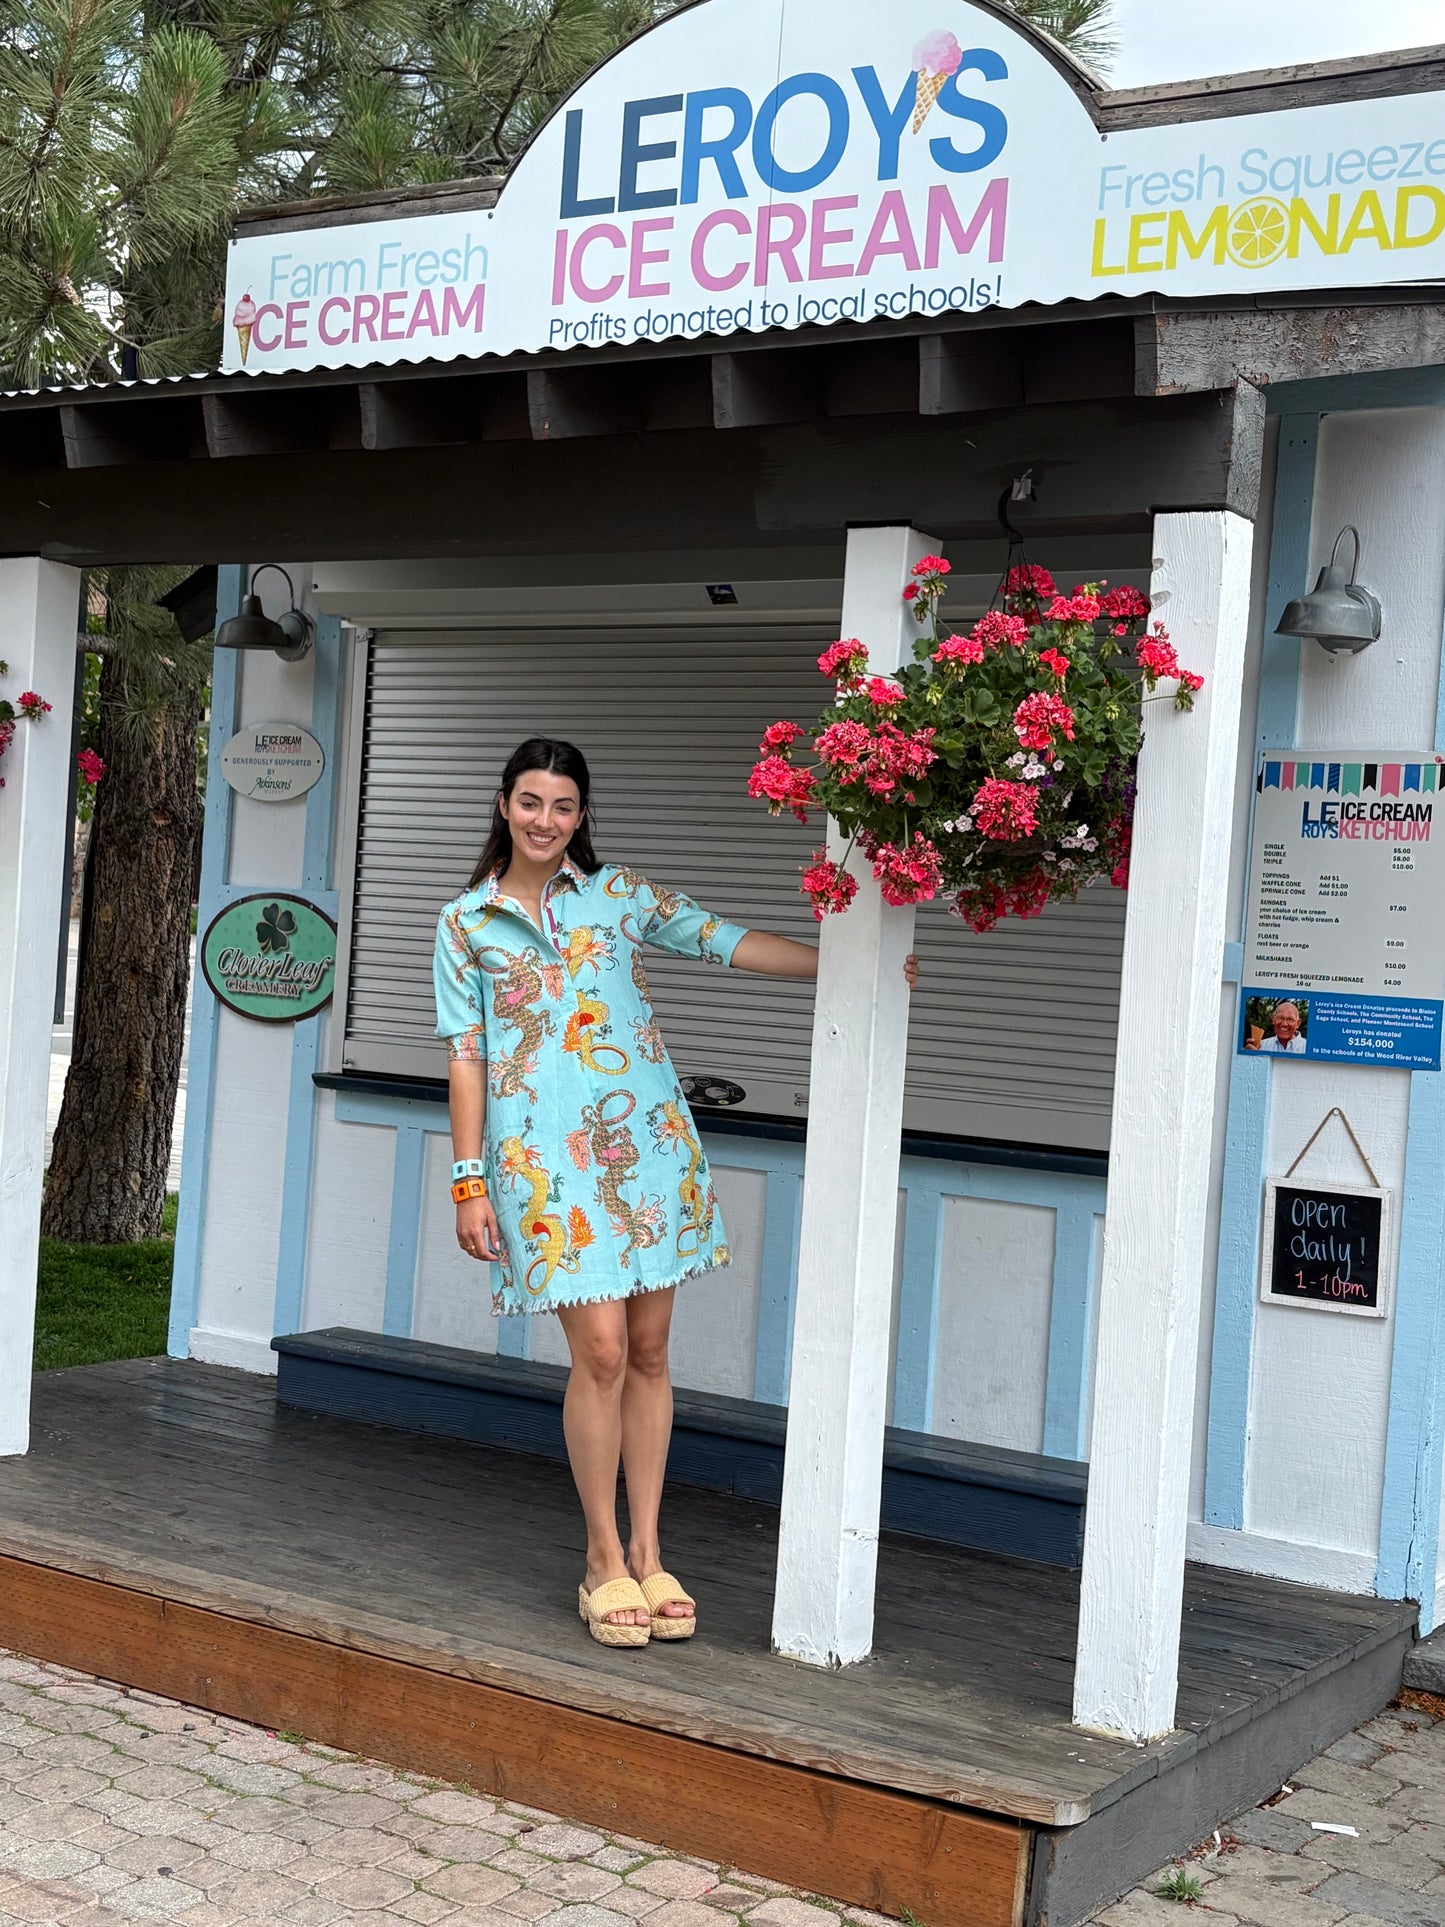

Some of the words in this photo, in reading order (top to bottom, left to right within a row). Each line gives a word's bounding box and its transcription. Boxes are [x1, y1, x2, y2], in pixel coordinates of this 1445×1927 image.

[1099, 153, 1225, 210] Fresh
[552, 217, 674, 306] ICE
[690, 178, 1009, 292] CREAM
[269, 252, 365, 301] Farm
[376, 233, 488, 290] Fresh
[318, 283, 485, 346] CREAM
[549, 312, 626, 344] Profits
[633, 300, 752, 337] donated
[760, 300, 789, 326] to
[797, 288, 866, 323] local
[874, 275, 1001, 315] schools!
[280, 735, 302, 745] CREAM
[232, 757, 273, 766] GENEROUSLY
[275, 758, 312, 767] SUPPORTED
[267, 768, 275, 776] BY
[1340, 802, 1367, 821] ICE
[1369, 802, 1432, 823] CREAM
[1338, 820, 1431, 841] KETCHUM
[1255, 955, 1293, 963] MILKSHAKES
[225, 977, 302, 998] CREAMERY
[1299, 973, 1331, 981] SQUEEZED
[1331, 975, 1364, 984] LEMONADE
[1347, 1037, 1394, 1049] $154,000
[1375, 1030, 1402, 1038] donated
[1395, 1053, 1412, 1061] River
[1413, 1055, 1433, 1064] Valley
[1291, 1198, 1347, 1229] Open
